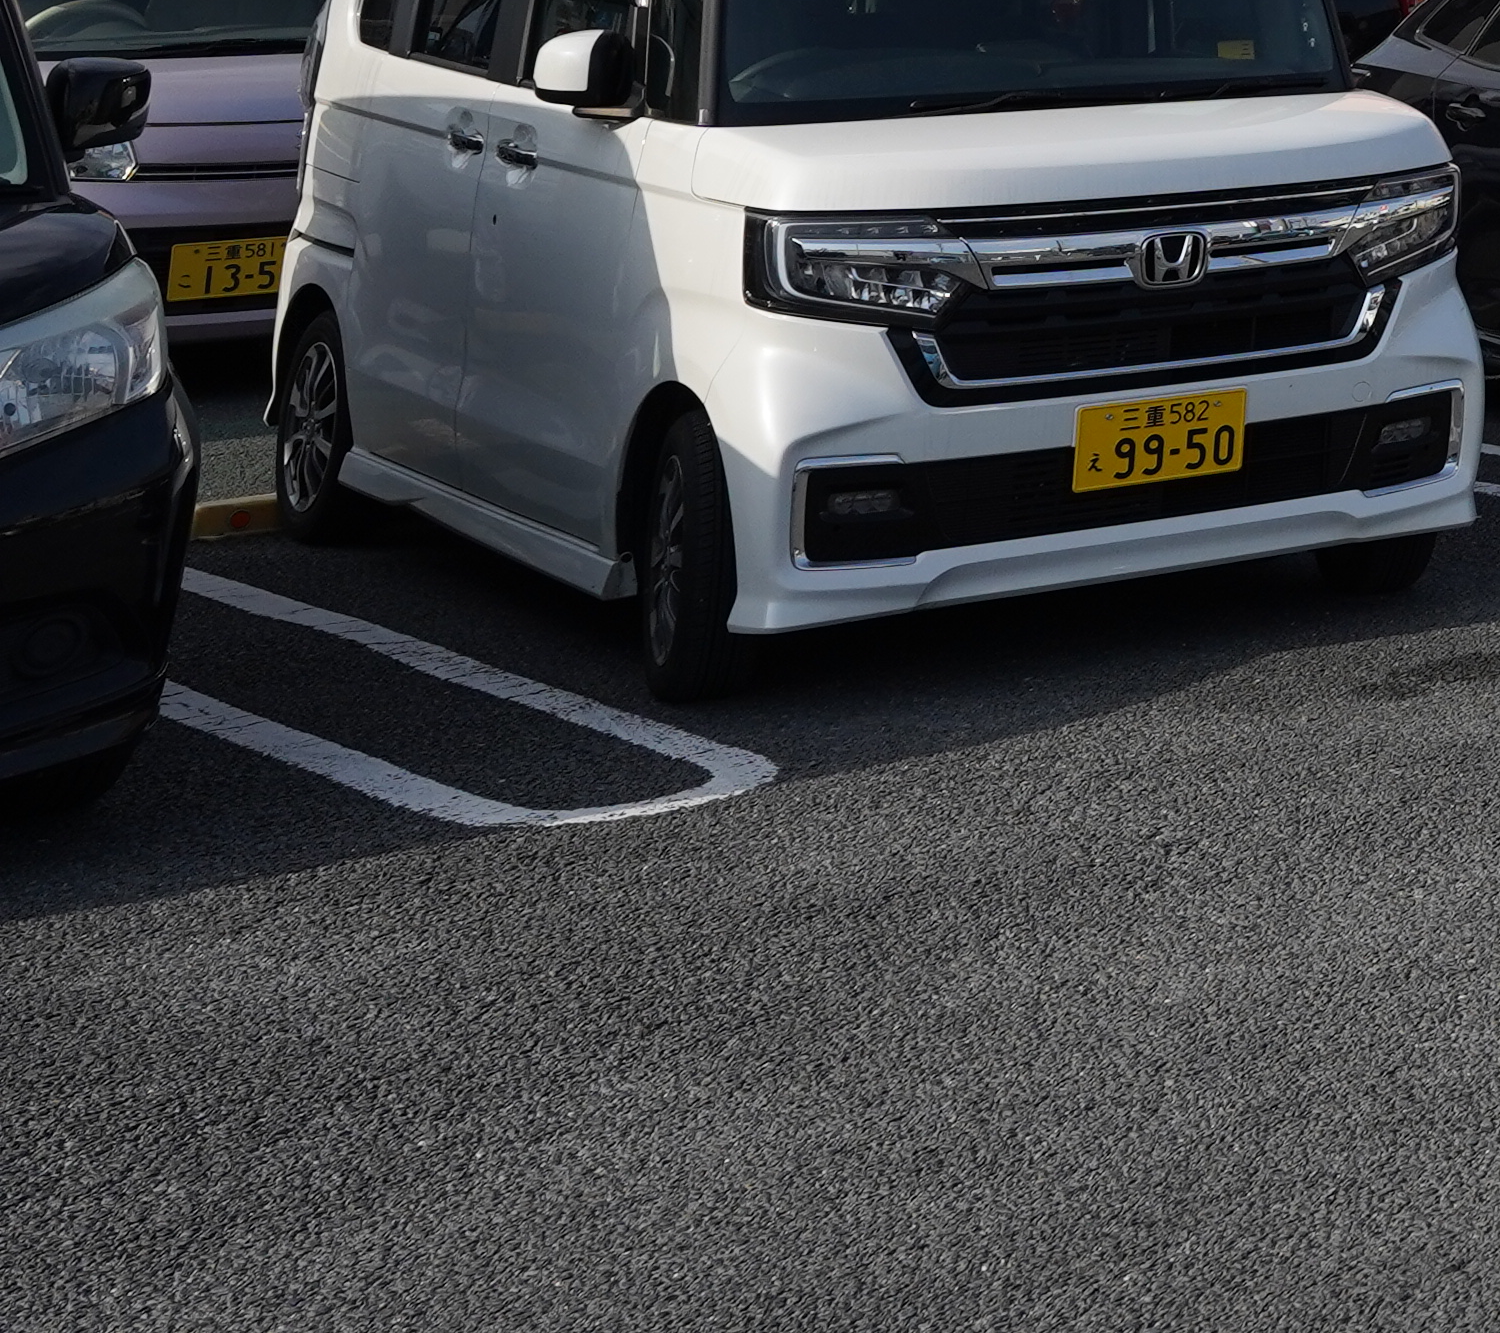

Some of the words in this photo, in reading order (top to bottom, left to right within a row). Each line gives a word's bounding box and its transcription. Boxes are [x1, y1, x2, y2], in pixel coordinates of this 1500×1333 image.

[177, 274, 192, 289] こ
[204, 260, 278, 295] 13-5
[1087, 452, 1103, 473] え
[1112, 424, 1236, 480] 99-50
